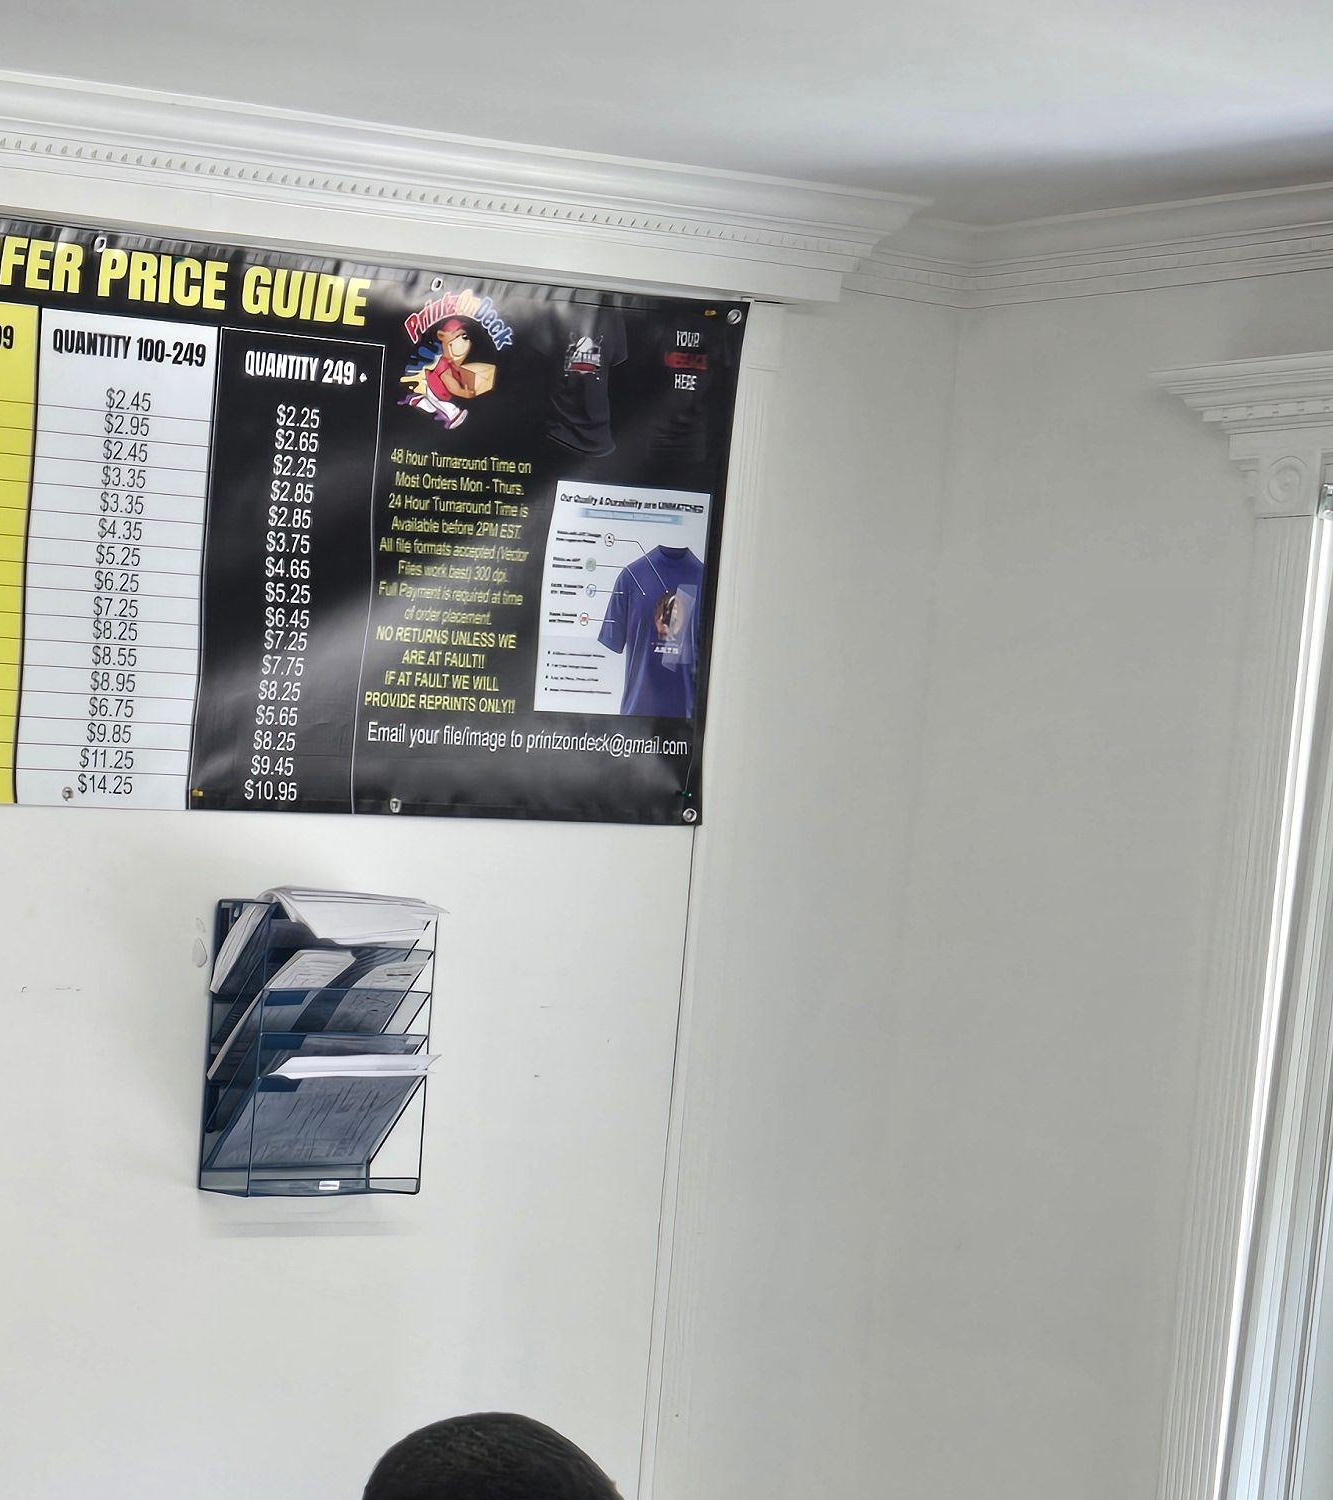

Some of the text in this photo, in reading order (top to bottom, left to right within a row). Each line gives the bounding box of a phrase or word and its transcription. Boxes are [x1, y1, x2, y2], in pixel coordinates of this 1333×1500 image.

[97, 248, 228, 310] PRICE
[242, 265, 371, 326] GUIDE
[52, 329, 207, 368] QUANTITY 100-249
[676, 331, 700, 347] YOUR
[244, 351, 355, 386] QUANTITY 249
[105, 389, 153, 414] $2.45
[104, 414, 152, 439] $2.95
[276, 406, 321, 430] $2.25
[102, 440, 149, 465] $2.45
[275, 430, 320, 454] $2.65
[101, 466, 147, 490] $3.35
[273, 455, 317, 479] $2.25
[99, 491, 145, 516] $3.35
[270, 480, 315, 504] $2.85
[267, 506, 312, 530] $2.85
[97, 519, 144, 542] $4.35
[266, 531, 311, 555] $3.75
[95, 543, 142, 568] $5.25
[265, 556, 311, 580] $4.65
[94, 569, 141, 592] $6.25
[265, 582, 311, 605] $5.25
[92, 595, 139, 619] $7.25
[265, 606, 310, 629] $6.45
[92, 619, 140, 642] $8.25
[264, 629, 309, 652] $7.25
[92, 645, 138, 669] $8.55
[261, 654, 305, 678] $7.75
[90, 671, 137, 695] $8.95
[258, 679, 302, 702] $8.25
[88, 696, 135, 720] $6.75
[365, 691, 516, 713] PROVIDE REPRINTS ONLY!!
[255, 704, 299, 728] $5.65
[86, 721, 133, 745] $9.85
[253, 730, 297, 752] $8.25
[367, 721, 689, 759] Email your file/image to printzondeck@gmail.com
[79, 748, 135, 771] $11.25
[250, 755, 295, 778] $9.45
[77, 773, 134, 798] $14.25
[244, 779, 299, 802] $10.95
